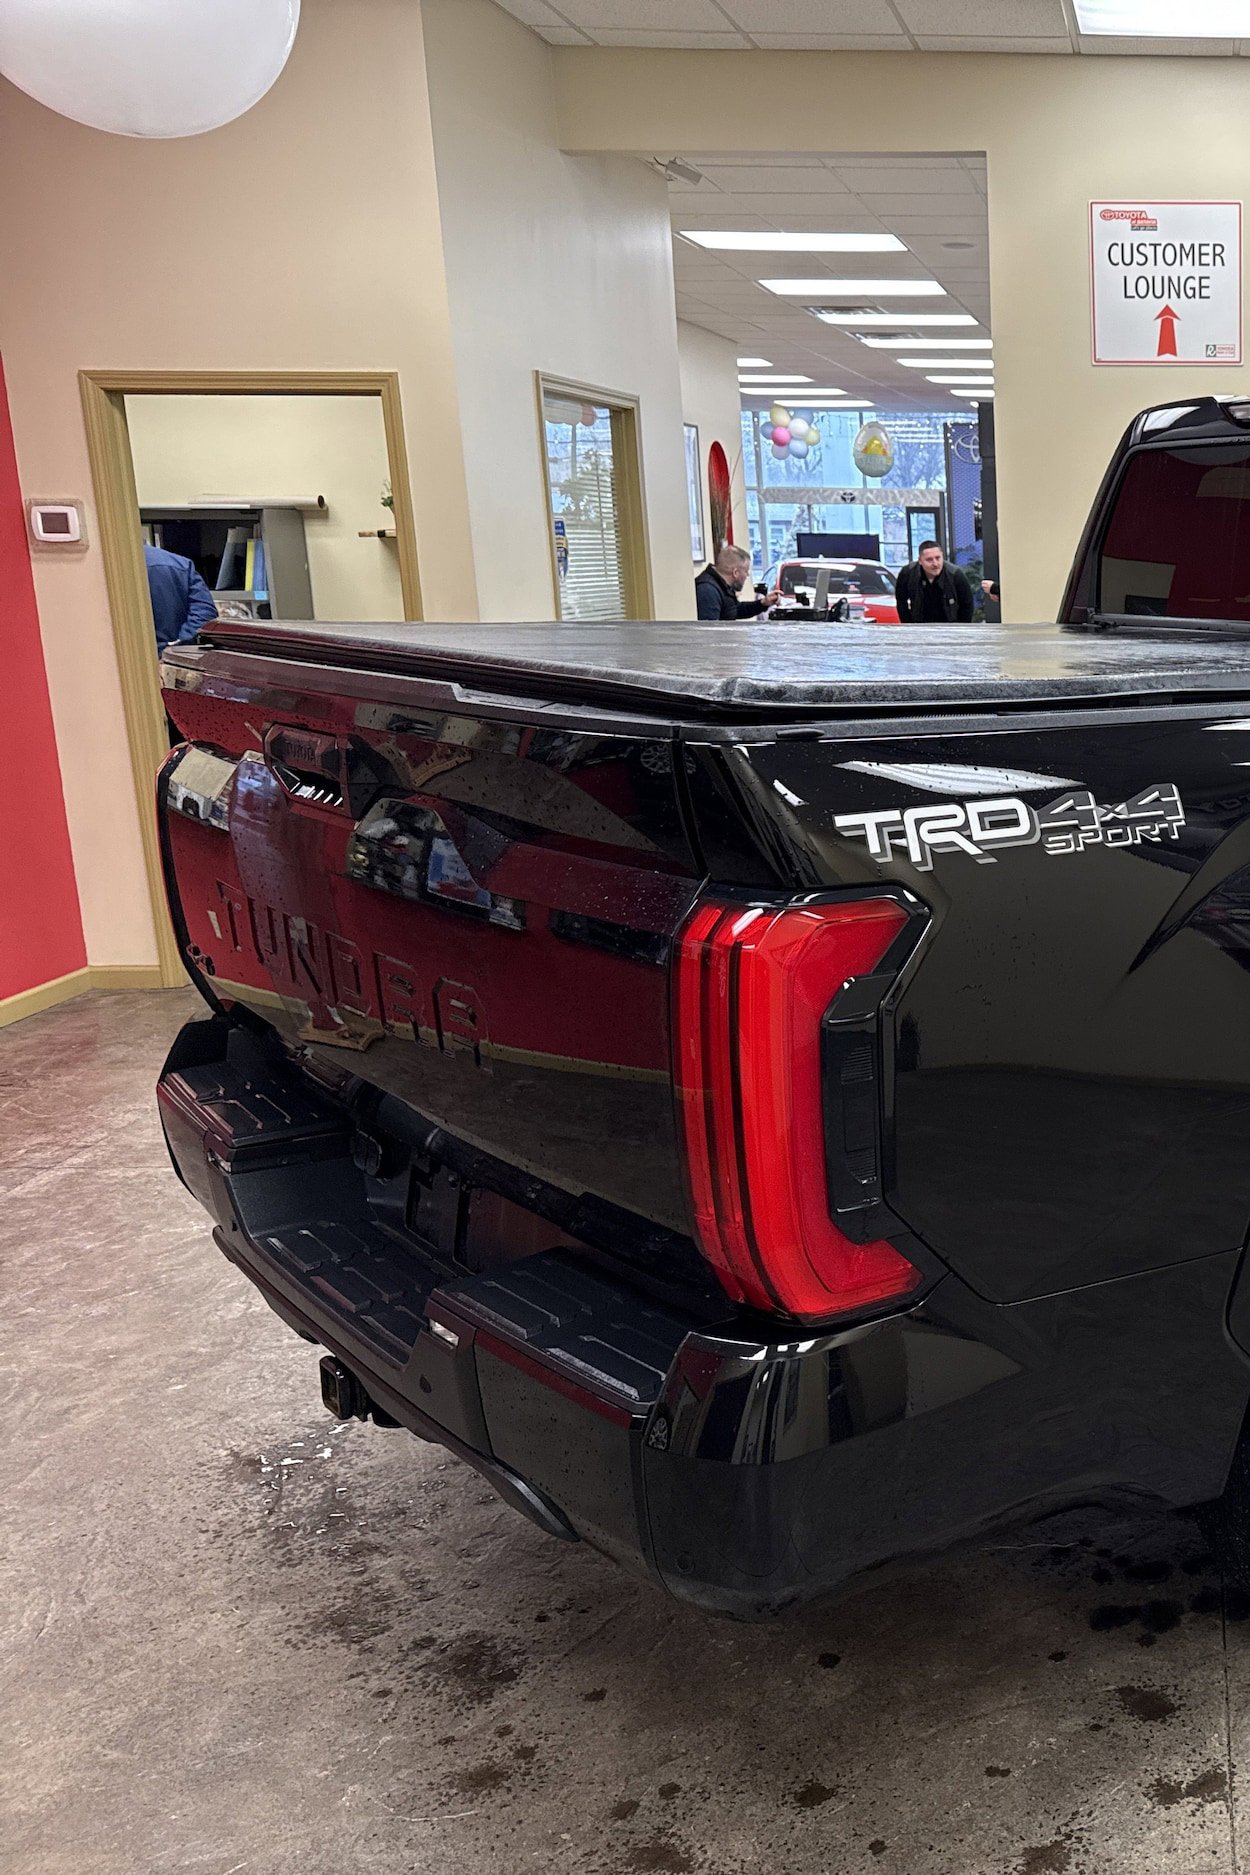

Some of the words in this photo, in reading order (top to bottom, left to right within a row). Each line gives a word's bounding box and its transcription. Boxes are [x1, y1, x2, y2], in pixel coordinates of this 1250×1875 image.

[1114, 210, 1148, 220] TOYOTA
[1107, 242, 1226, 267] CUSTOMER
[1123, 275, 1211, 300] LOUNGE
[832, 797, 1041, 873] TRD
[1036, 783, 1186, 830] 4x4
[1044, 817, 1187, 856] SPORT
[214, 877, 496, 1078] TUNDRA
